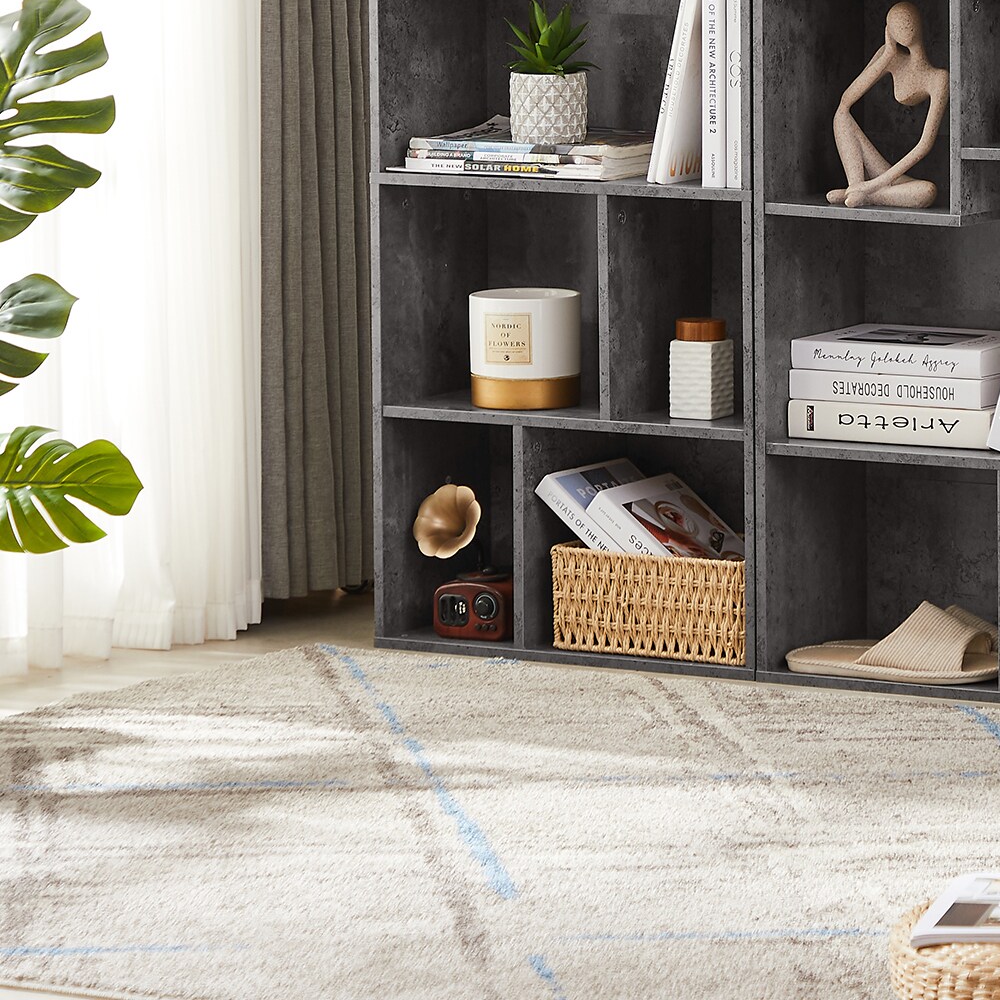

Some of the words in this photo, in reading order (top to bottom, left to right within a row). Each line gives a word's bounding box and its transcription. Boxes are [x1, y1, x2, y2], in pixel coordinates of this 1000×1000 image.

[708, 4, 716, 16] OF
[708, 18, 716, 35] THE
[677, 21, 690, 68] DECORATES
[708, 38, 716, 60] NEW
[729, 50, 743, 89] COS
[708, 61, 717, 125] ARCHITECTURE
[437, 140, 467, 149] Wallpaper
[464, 163, 500, 172] SOLAR
[503, 164, 539, 173] HOME
[832, 380, 889, 397] DECORATES
[897, 384, 955, 401] HOUSEHOLD
[838, 413, 960, 434] Arletta
[575, 518, 585, 530] OF
[585, 528, 598, 543] THE
[597, 540, 610, 552] NE
